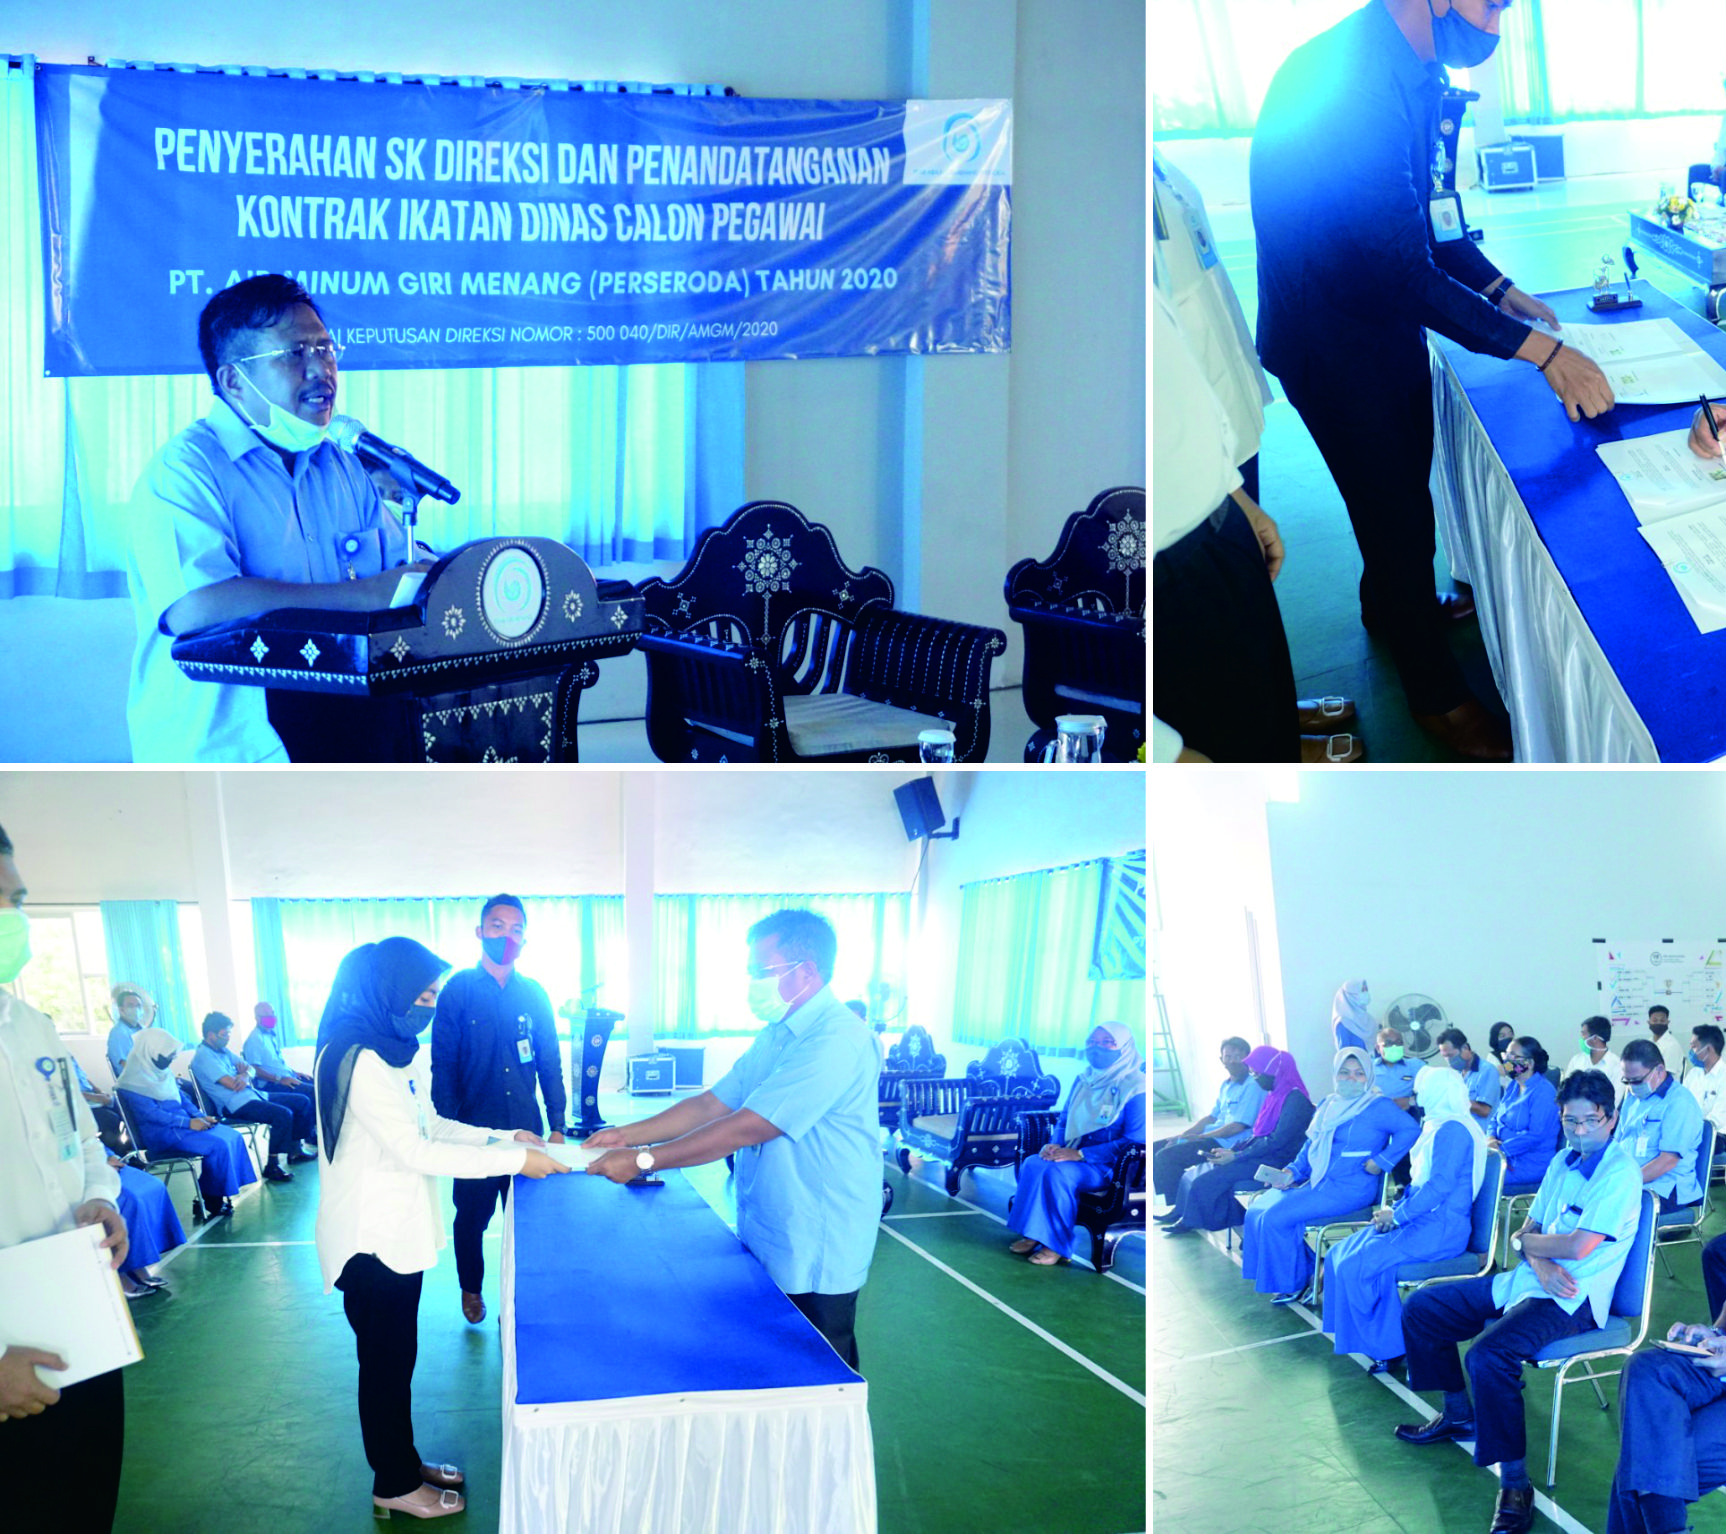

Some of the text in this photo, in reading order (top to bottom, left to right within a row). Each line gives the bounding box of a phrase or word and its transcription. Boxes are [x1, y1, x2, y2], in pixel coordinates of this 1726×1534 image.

[155, 127, 890, 185] PENYERAHAN SK DIREKSI DAN PENANDATANGANAN
[236, 195, 826, 242] KONTRAK IKATAN DINAS CALON PEGAWAI
[169, 269, 213, 295] PT.
[398, 271, 452, 295] GIRI
[460, 271, 582, 295] MENANG
[589, 268, 750, 299] (PERSERODA)
[756, 268, 835, 292] TAHUN
[841, 267, 898, 290] 2020
[347, 327, 440, 344] KEPUTUSAN
[445, 327, 506, 343] DIREKSI
[510, 325, 573, 343] NOMOR
[587, 325, 615, 341] 500
[619, 320, 779, 344] 040/DIR/AMGM/2020
